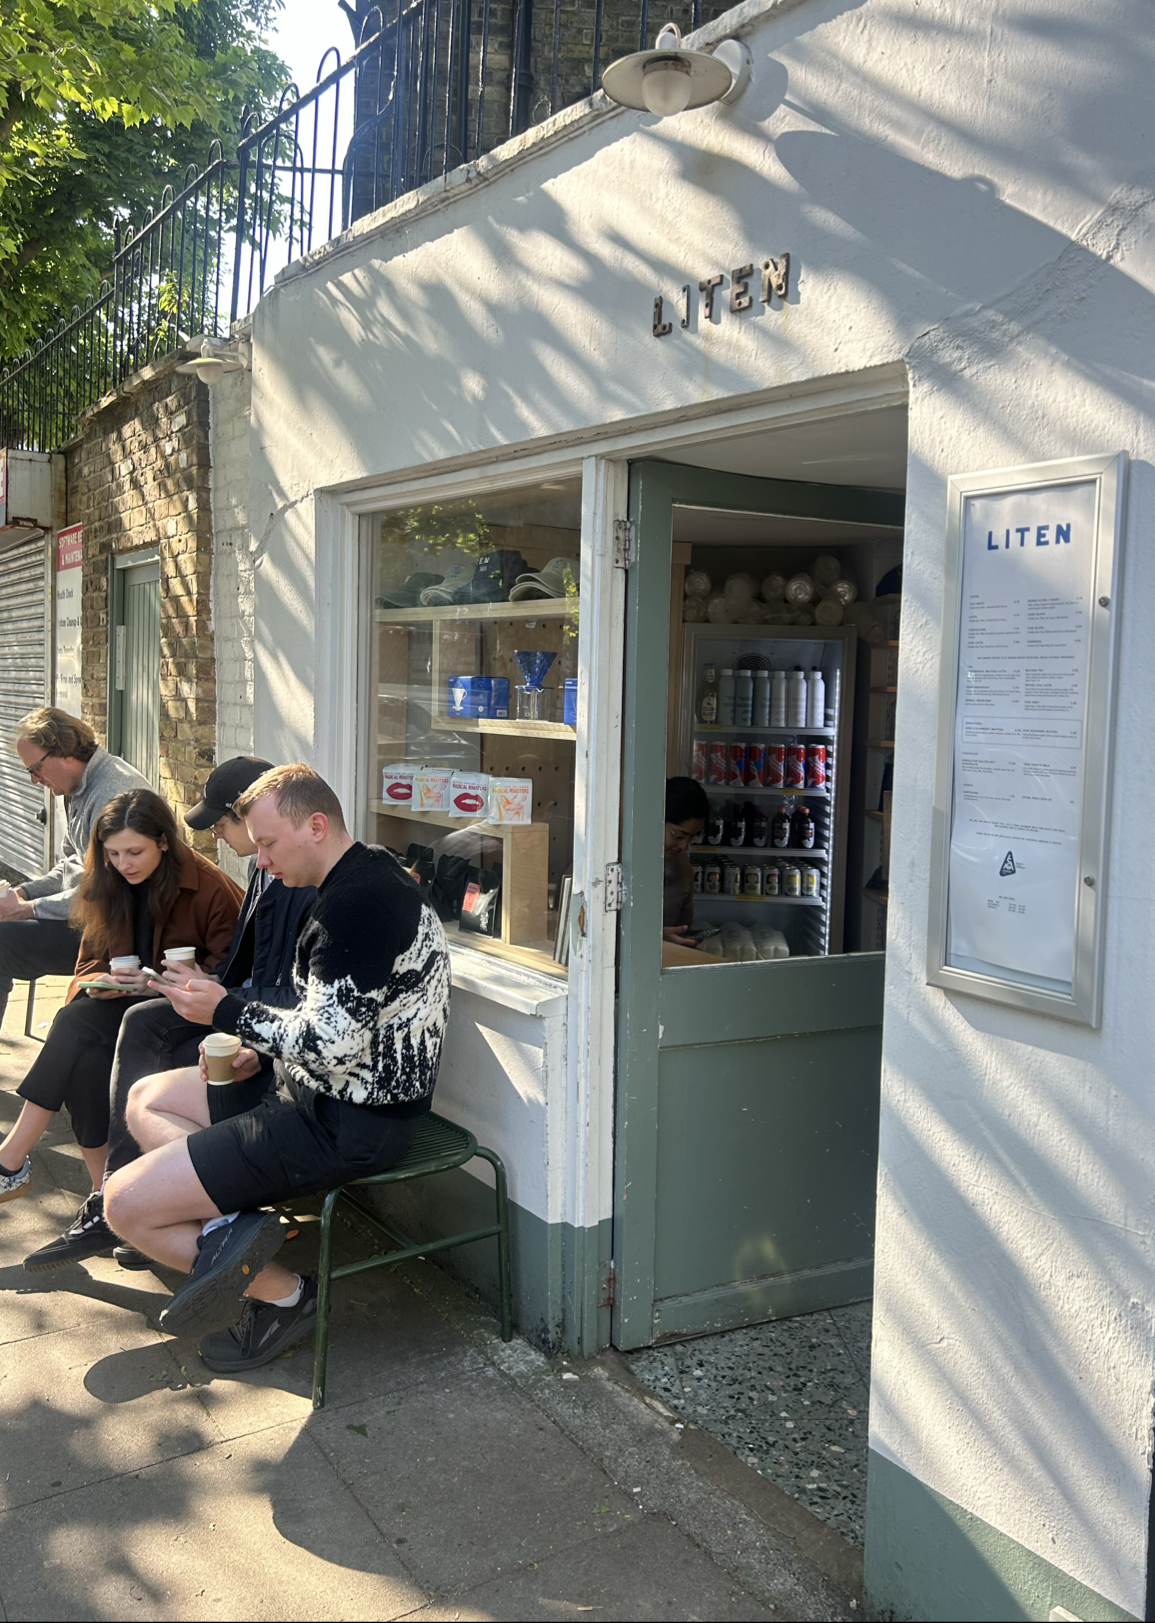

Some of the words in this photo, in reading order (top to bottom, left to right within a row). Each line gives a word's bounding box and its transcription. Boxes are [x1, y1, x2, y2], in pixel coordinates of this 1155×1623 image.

[653, 252, 790, 338] LITEN
[59, 532, 77, 550] SOFTWARE
[987, 522, 1072, 551] LITEN
[211, 1227, 233, 1266] ALTRA
